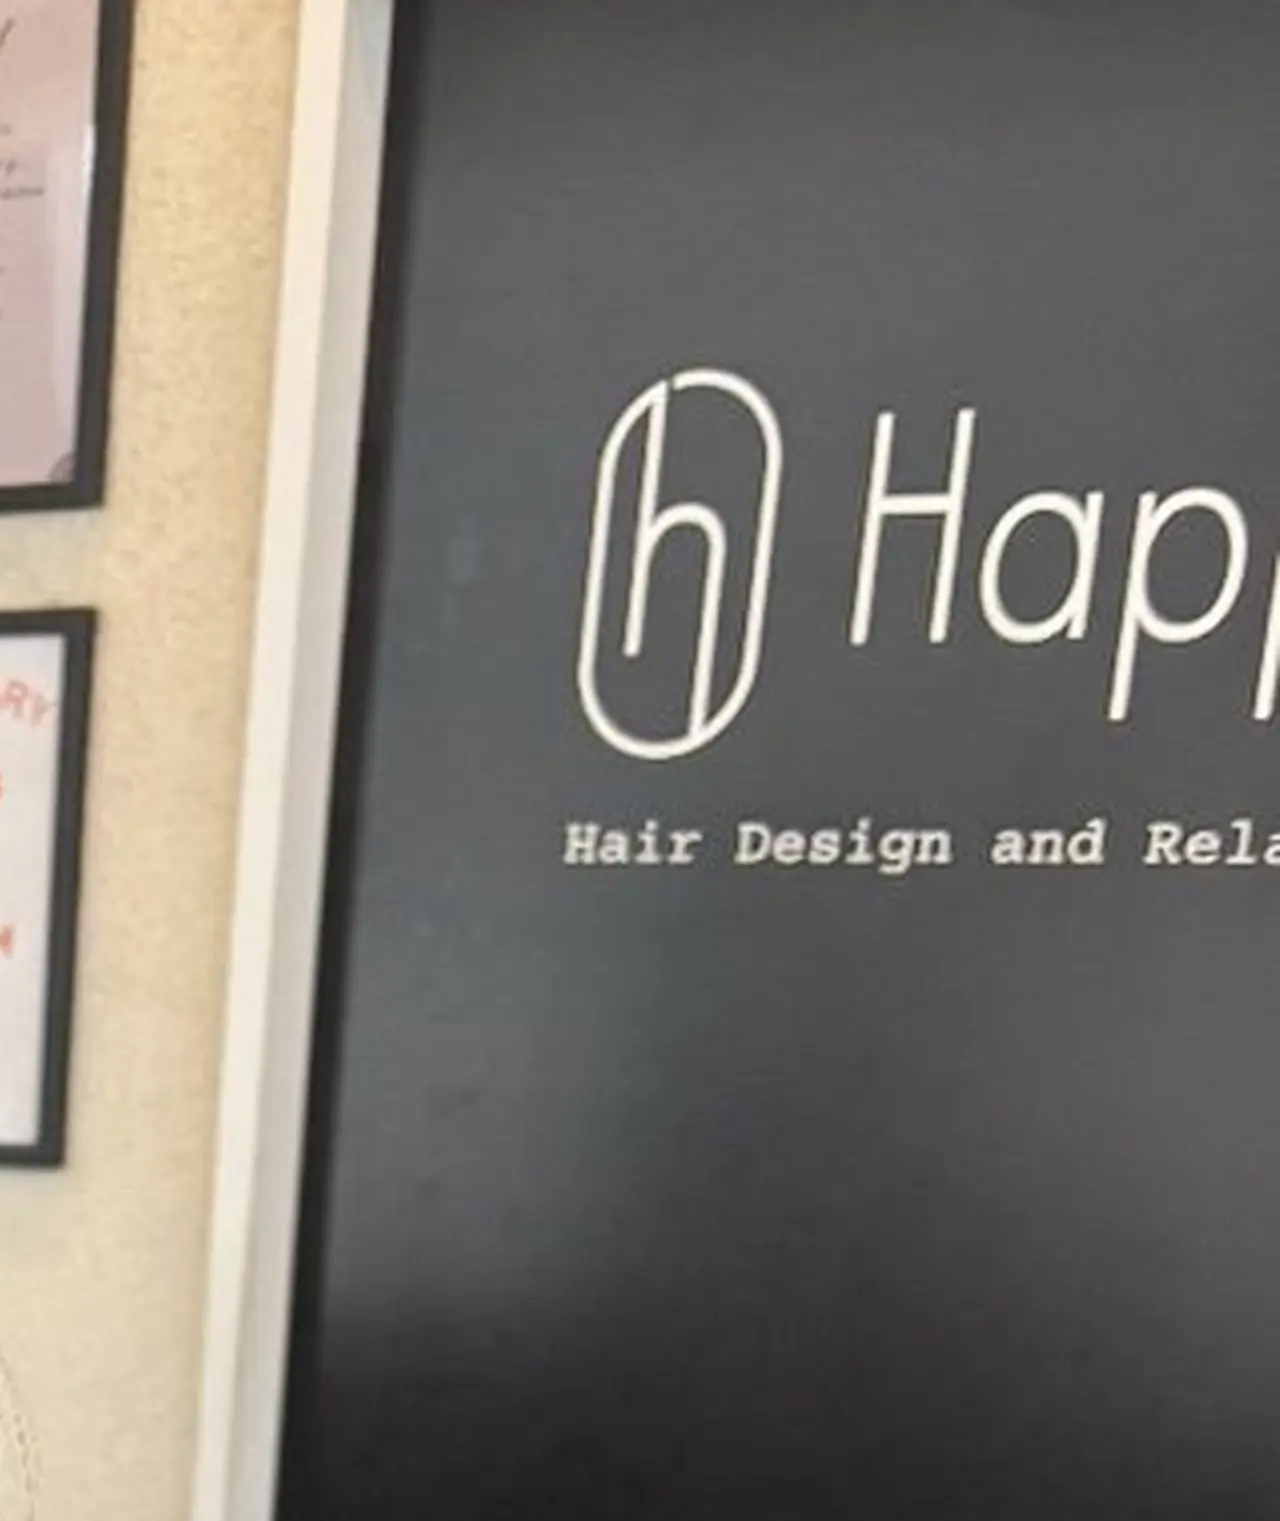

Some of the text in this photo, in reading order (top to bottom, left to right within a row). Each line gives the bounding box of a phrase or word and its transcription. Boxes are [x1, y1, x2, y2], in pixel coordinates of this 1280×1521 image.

[564, 820, 702, 866] Hair
[733, 817, 952, 874] Design
[991, 818, 1107, 866] and
